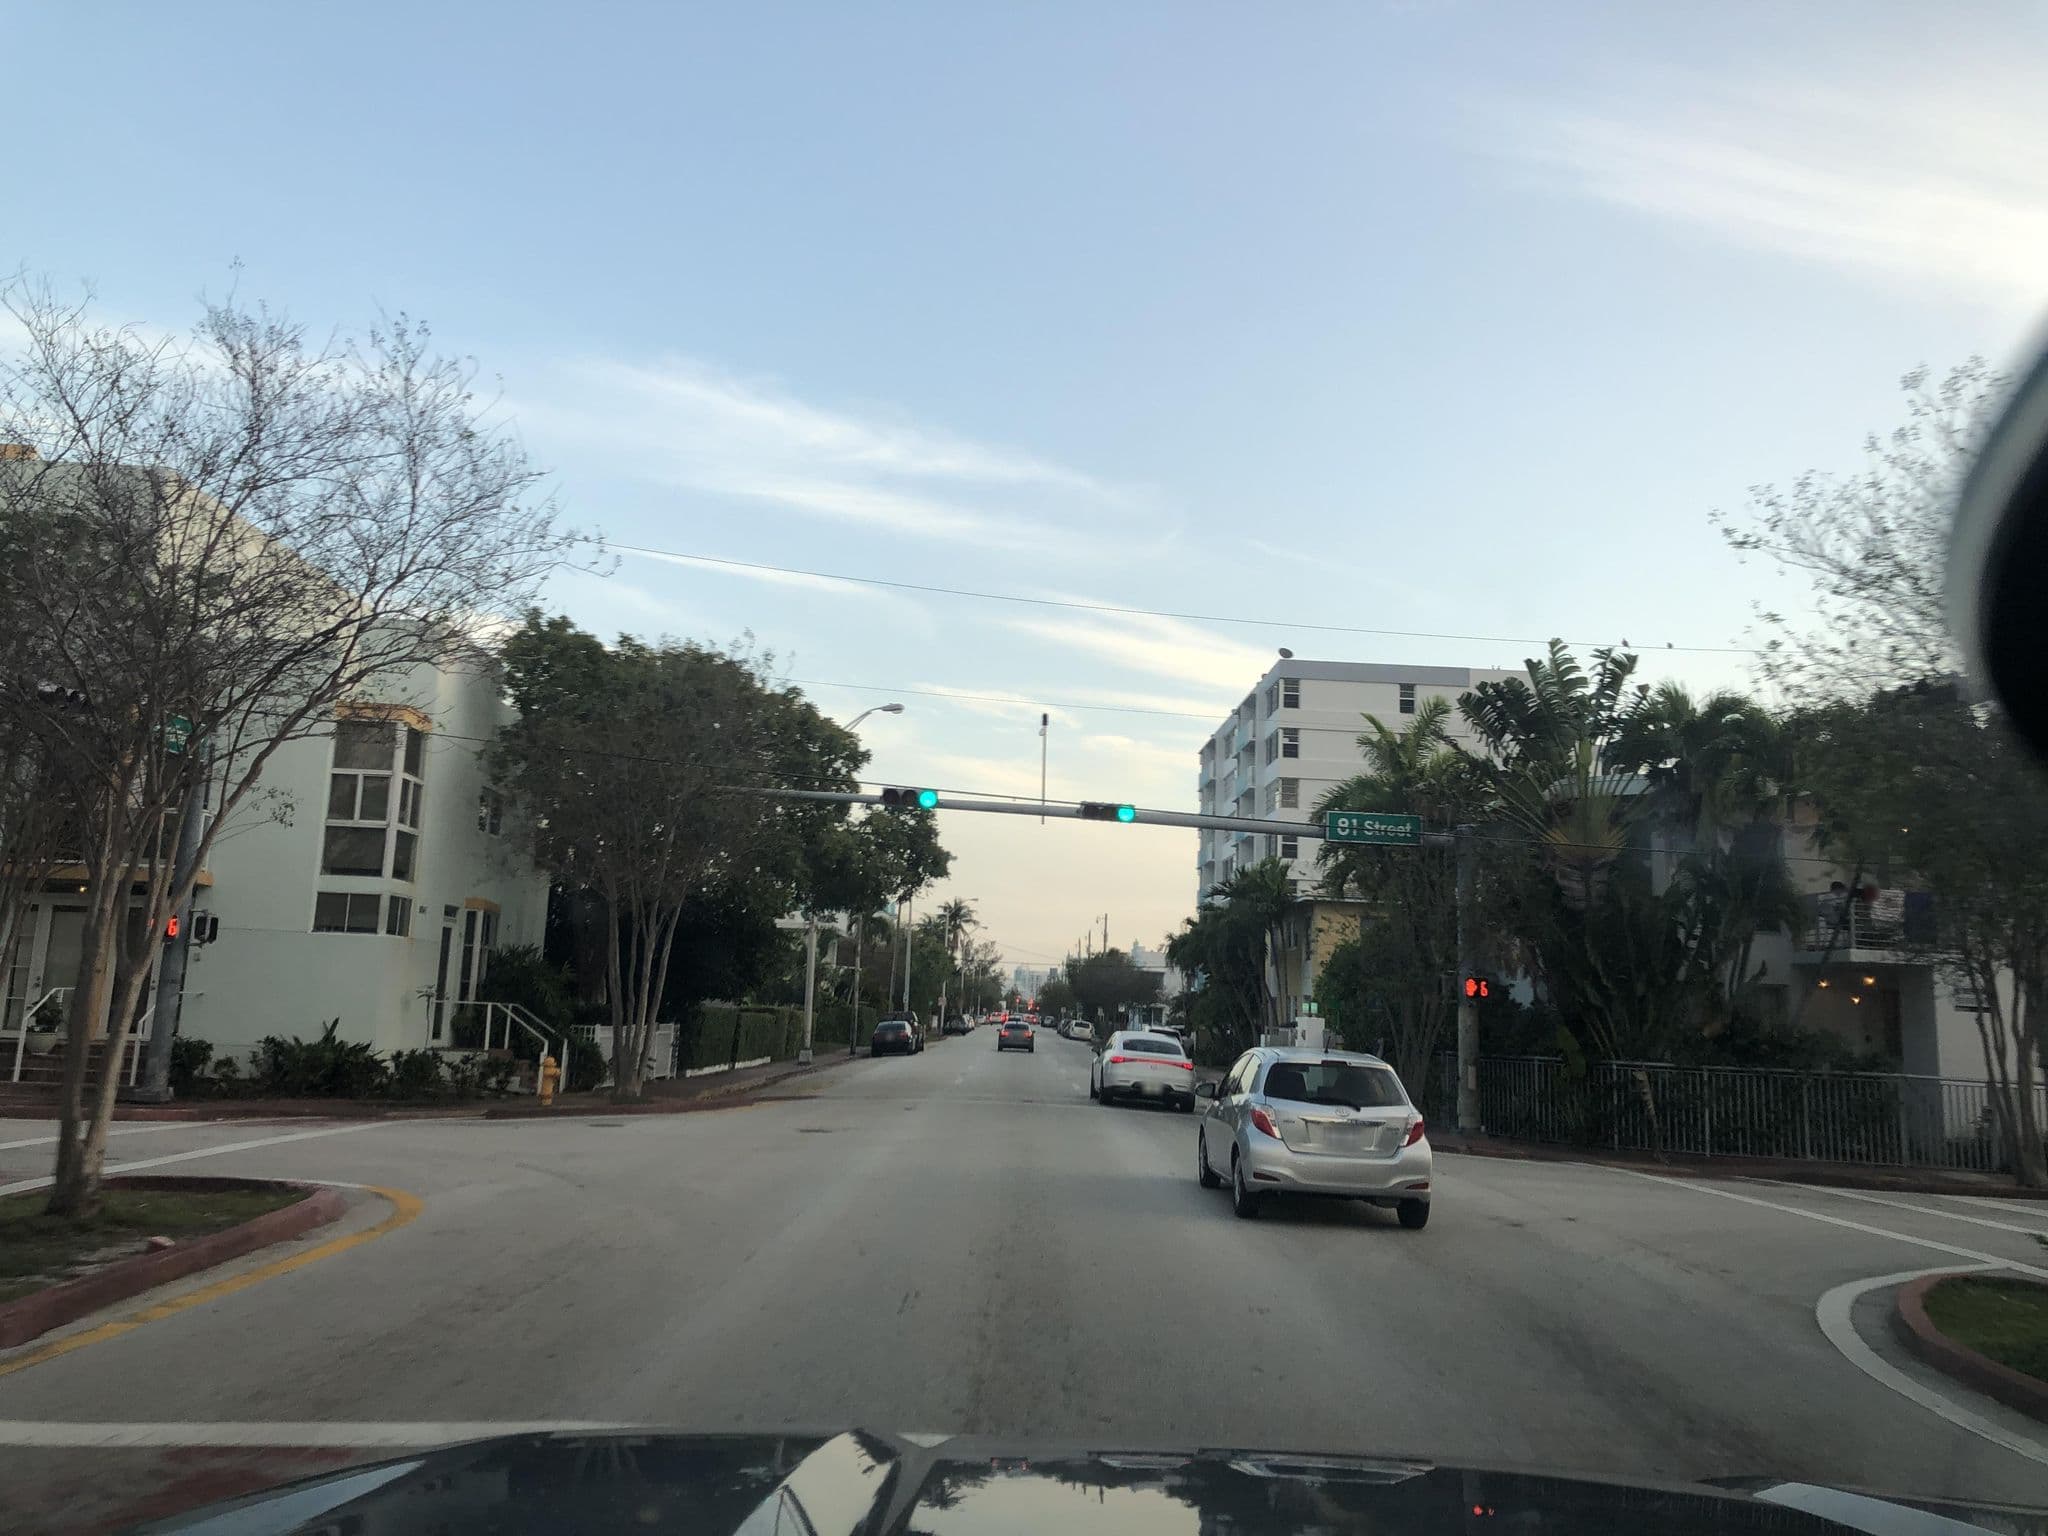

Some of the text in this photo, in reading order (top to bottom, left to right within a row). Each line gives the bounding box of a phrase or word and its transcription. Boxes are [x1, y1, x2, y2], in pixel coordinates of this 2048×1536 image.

[1337, 817, 1412, 837] 81 Street
[1480, 981, 1488, 997] 6
